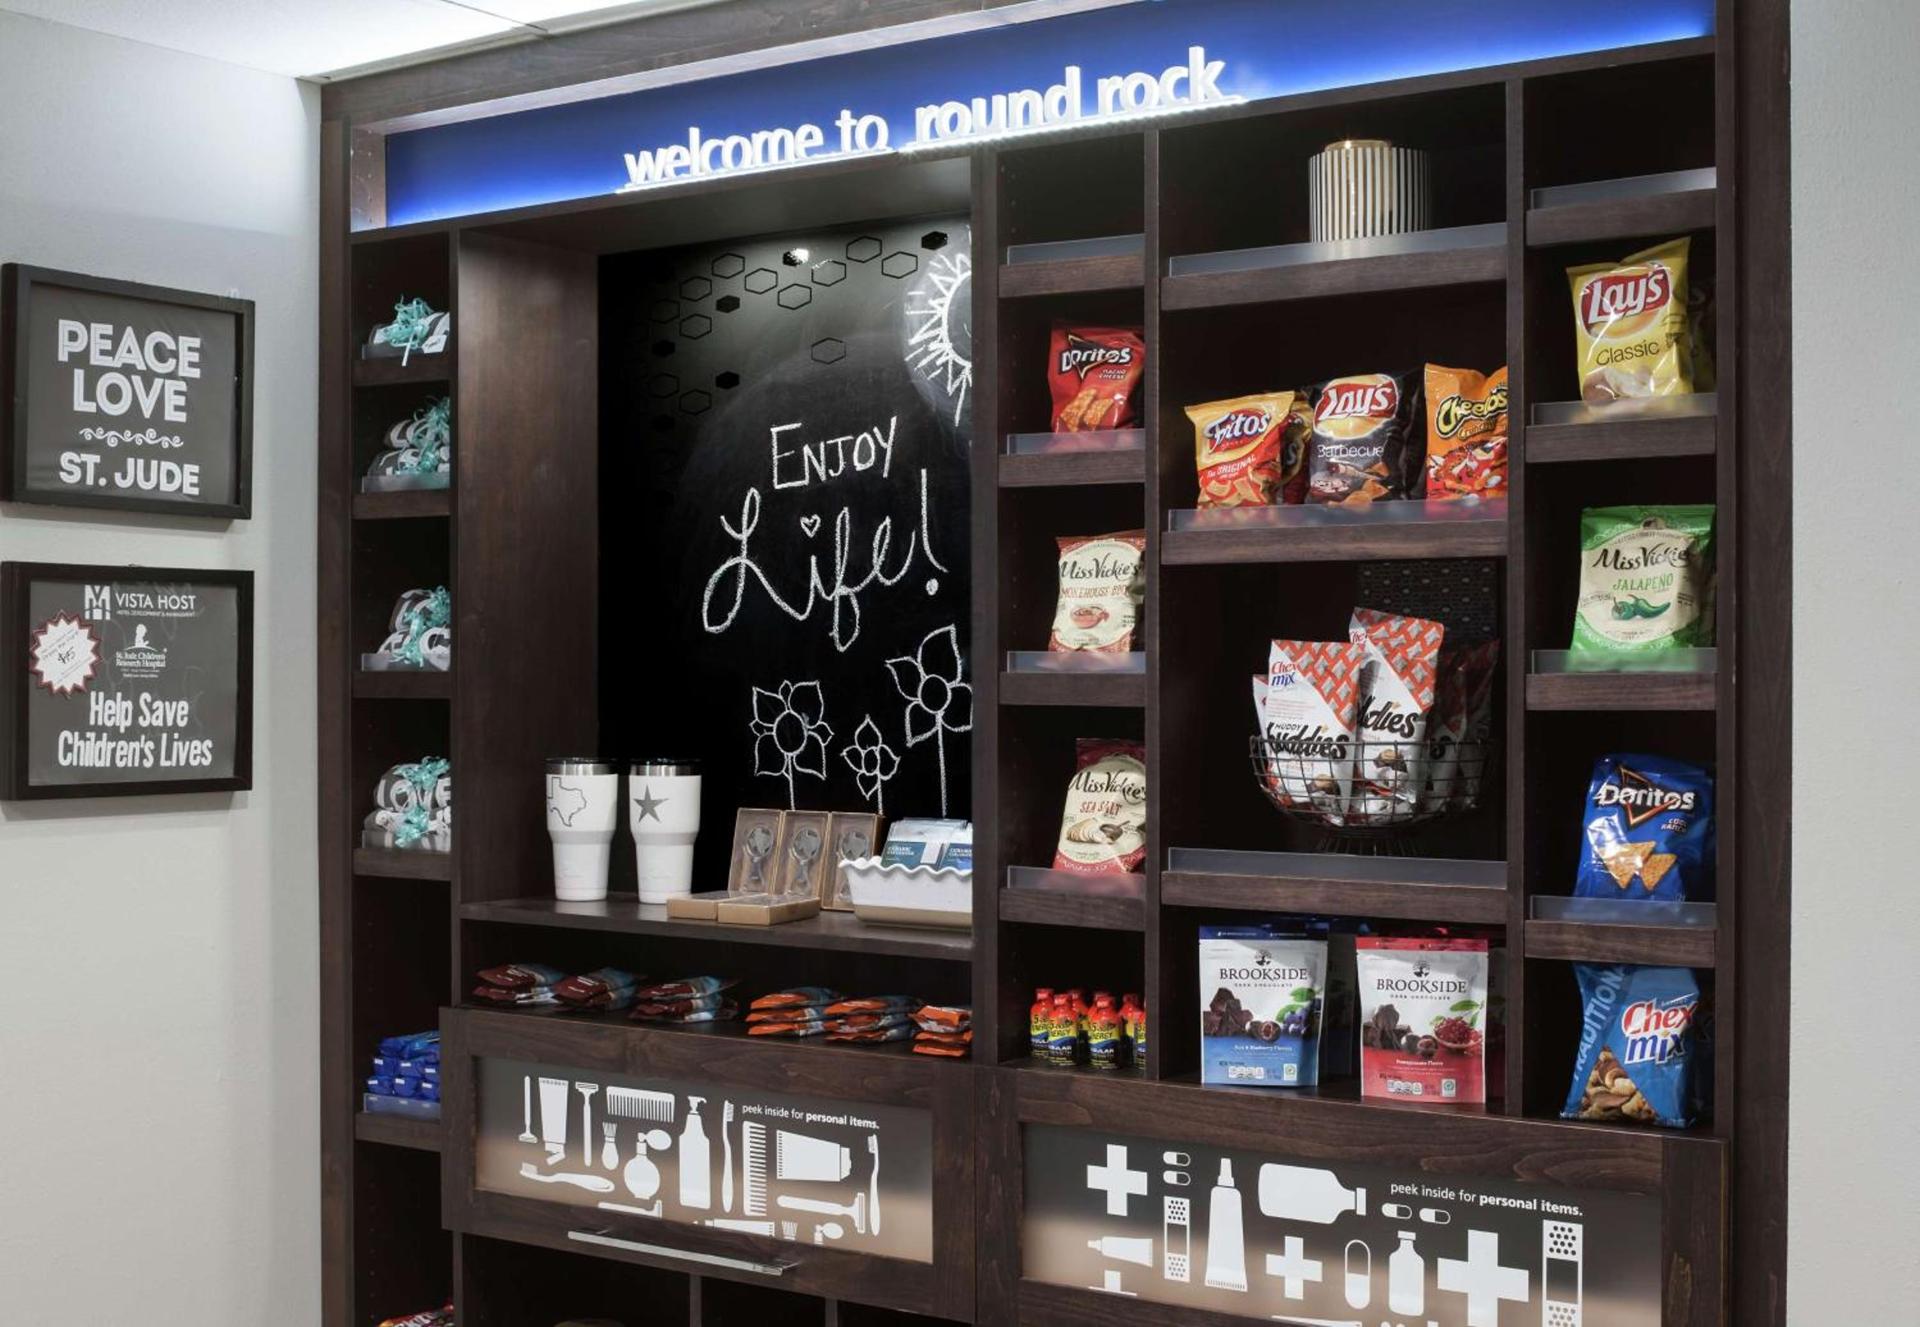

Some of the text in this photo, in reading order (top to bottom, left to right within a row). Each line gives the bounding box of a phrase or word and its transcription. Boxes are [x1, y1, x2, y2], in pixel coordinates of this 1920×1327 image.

[624, 46, 1227, 185] welcome to round rock
[57, 318, 202, 379] PEACE
[1061, 347, 1132, 372] Doritos
[1596, 339, 1660, 366] Classic
[73, 368, 188, 423] LOVE
[1204, 412, 1271, 454] Fritos
[1318, 443, 1385, 458] Barbecue
[59, 451, 200, 496] ST. JUDE
[1592, 548, 1641, 570] Miss
[115, 592, 196, 610] VISTA HOST
[1271, 672, 1295, 686] mix
[89, 690, 189, 734] Help Save
[58, 730, 213, 768] Children's Lives
[1068, 771, 1105, 793] Miss
[1598, 784, 1695, 810] Doritos
[1219, 968, 1308, 982] BROOKSIDE
[1377, 978, 1467, 993] BROOKSIDE
[1623, 1002, 1697, 1035] Chex
[1627, 1031, 1683, 1062] mix
[742, 1104, 880, 1129] peek inside for personal items.
[1390, 1183, 1583, 1216] peek inside for personal items.
